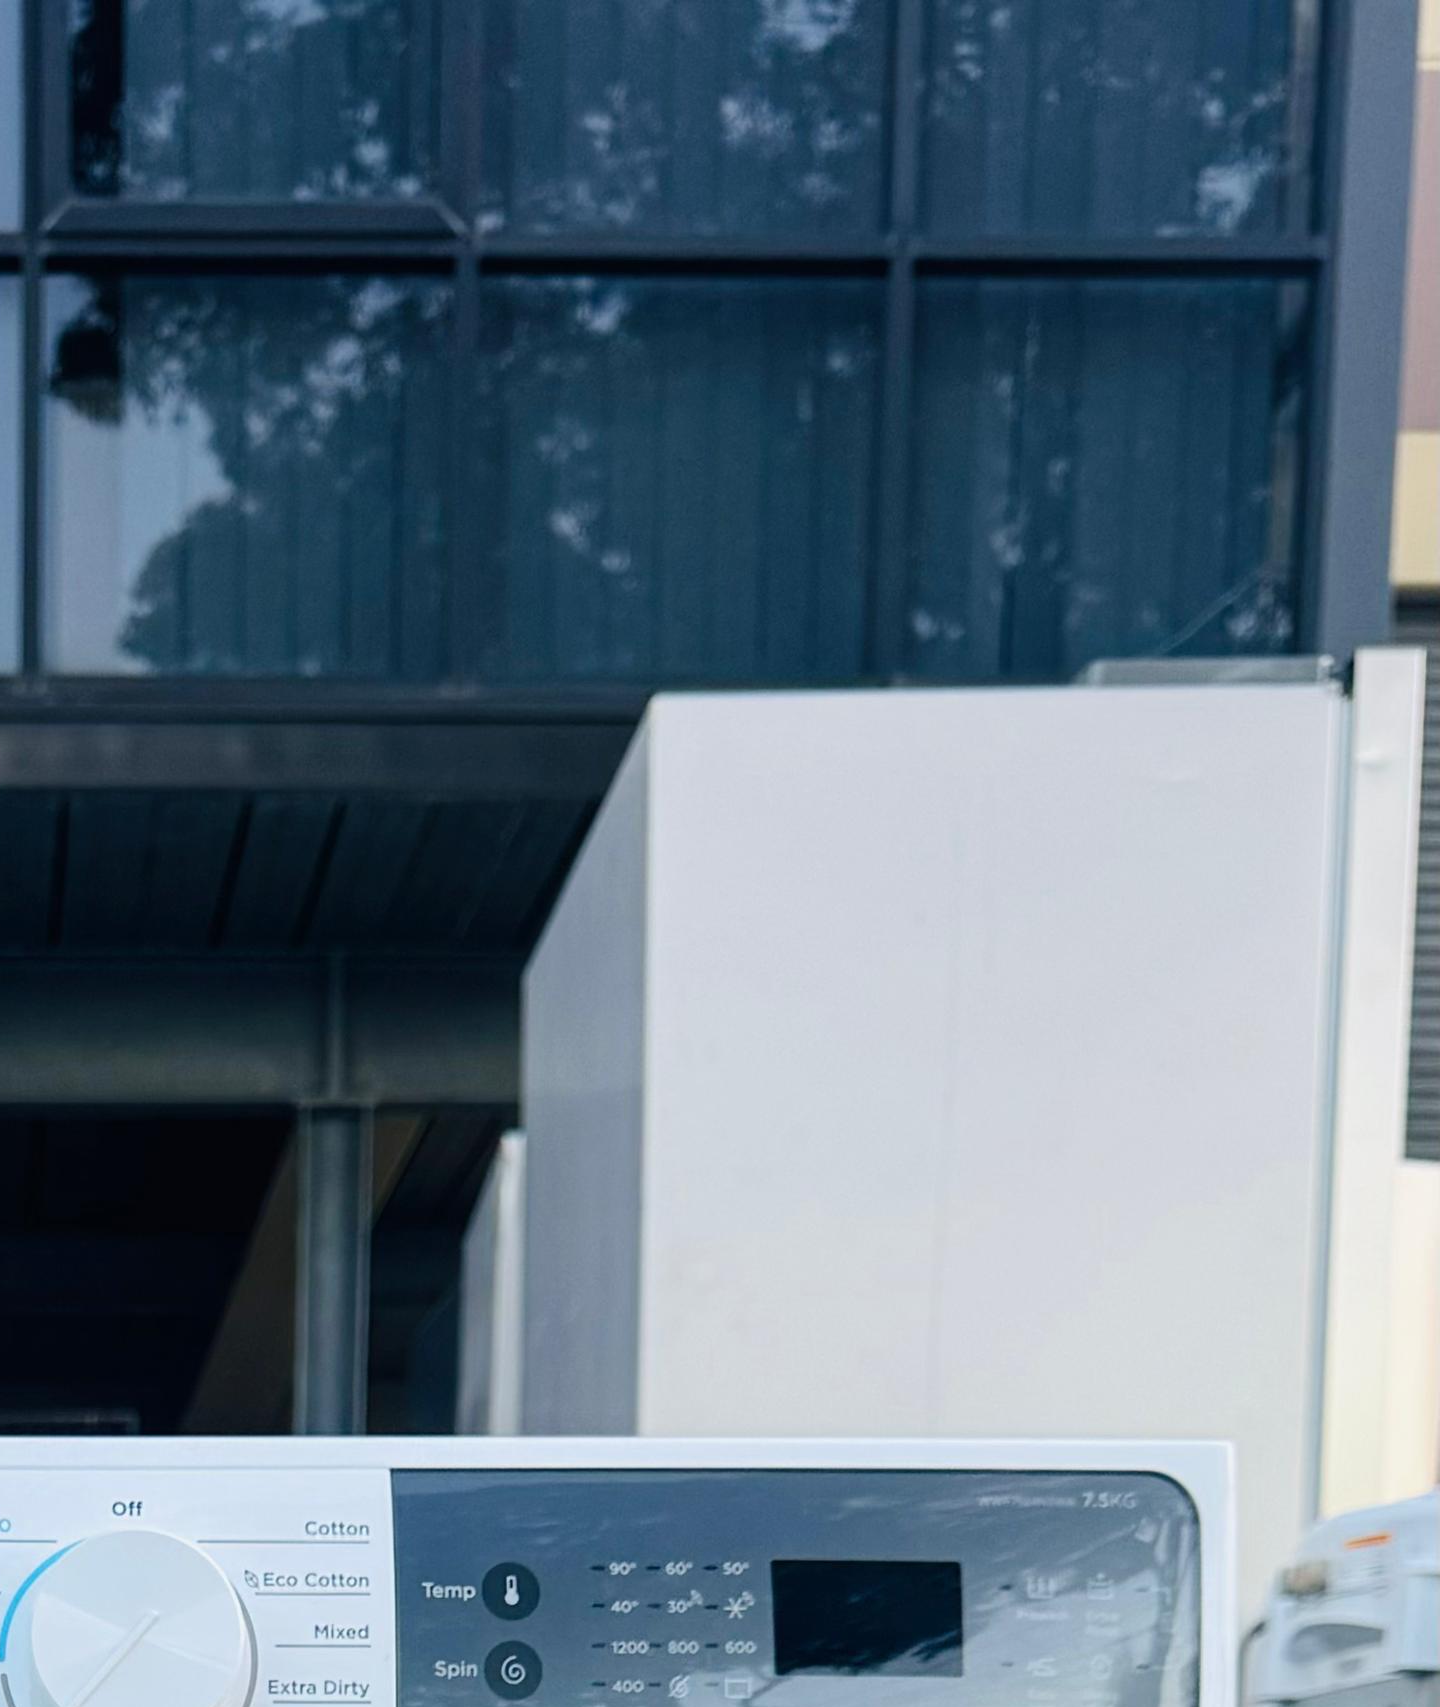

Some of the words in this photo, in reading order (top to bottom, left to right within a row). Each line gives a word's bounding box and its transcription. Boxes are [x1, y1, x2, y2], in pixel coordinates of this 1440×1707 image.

[111, 1500, 143, 1517] Off
[304, 1520, 370, 1537] Cotton
[262, 1571, 298, 1588] Eco
[304, 1572, 370, 1588] Cotton
[421, 1582, 477, 1602] Temp
[314, 1623, 370, 1640] Mixed
[611, 1639, 650, 1655] 1200
[667, 1639, 700, 1655] 800
[724, 1639, 758, 1655] 600
[433, 1659, 479, 1680] Spin
[267, 1679, 317, 1696] Extra
[323, 1679, 370, 1699] Dirty
[612, 1679, 645, 1694] 400
